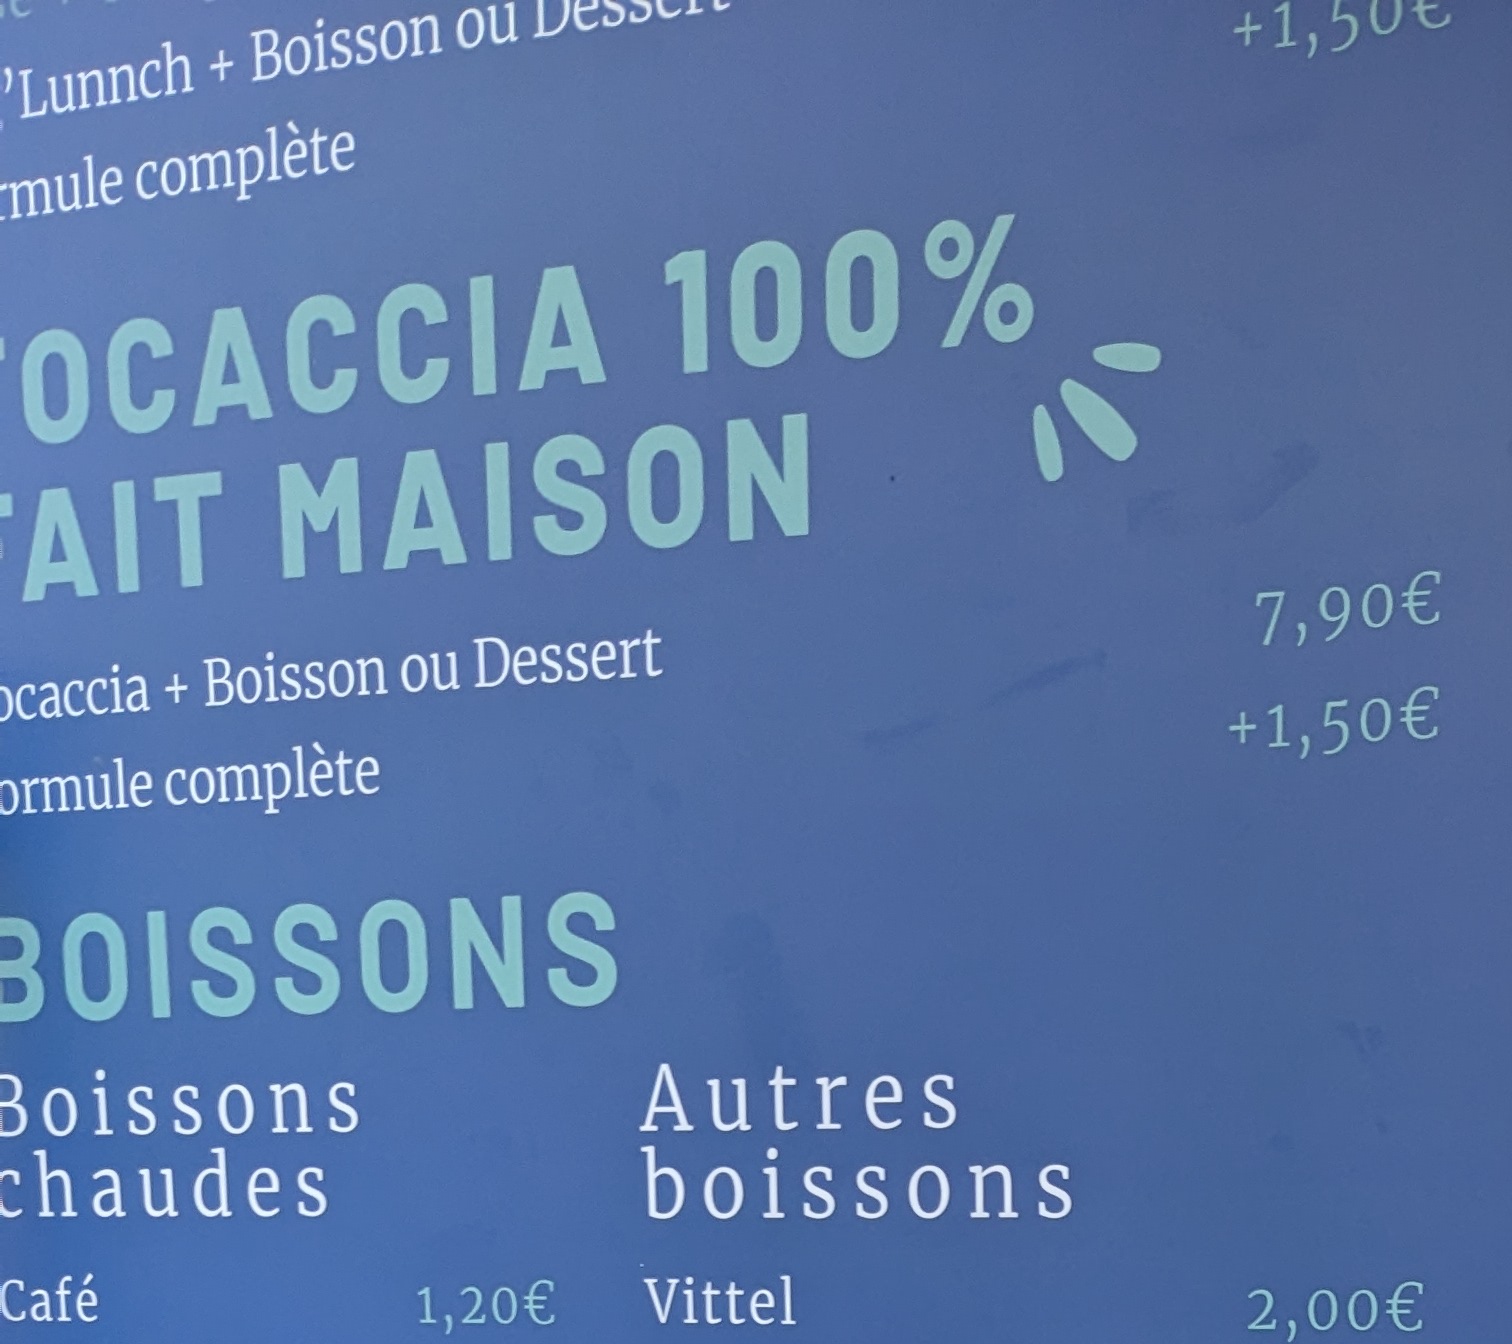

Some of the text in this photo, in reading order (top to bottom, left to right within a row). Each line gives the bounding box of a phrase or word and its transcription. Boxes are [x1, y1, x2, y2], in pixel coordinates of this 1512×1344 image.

[250, 1, 519, 82] Boisson ou
[135, 120, 355, 202] complète
[0, 213, 1034, 445] OCACCIA 100%
[0, 412, 809, 603] AIT MAISON
[1255, 570, 1442, 647] 7,90€
[202, 651, 389, 707] Boisson
[400, 651, 461, 693] ou
[472, 629, 663, 688] Dessert
[1228, 685, 1439, 760] +1,50€
[165, 741, 380, 815] complète
[0, 891, 618, 1023] BOISSONS
[0, 1069, 359, 1138] Boissons
[638, 1063, 957, 1132] Autres
[0, 1146, 327, 1218] chaudes
[640, 1145, 1072, 1220] boissons
[0, 1272, 98, 1323] Café
[417, 1279, 555, 1335] 1,20€
[643, 1274, 797, 1325] Vittel
[1247, 1281, 1424, 1343] 2,00€
